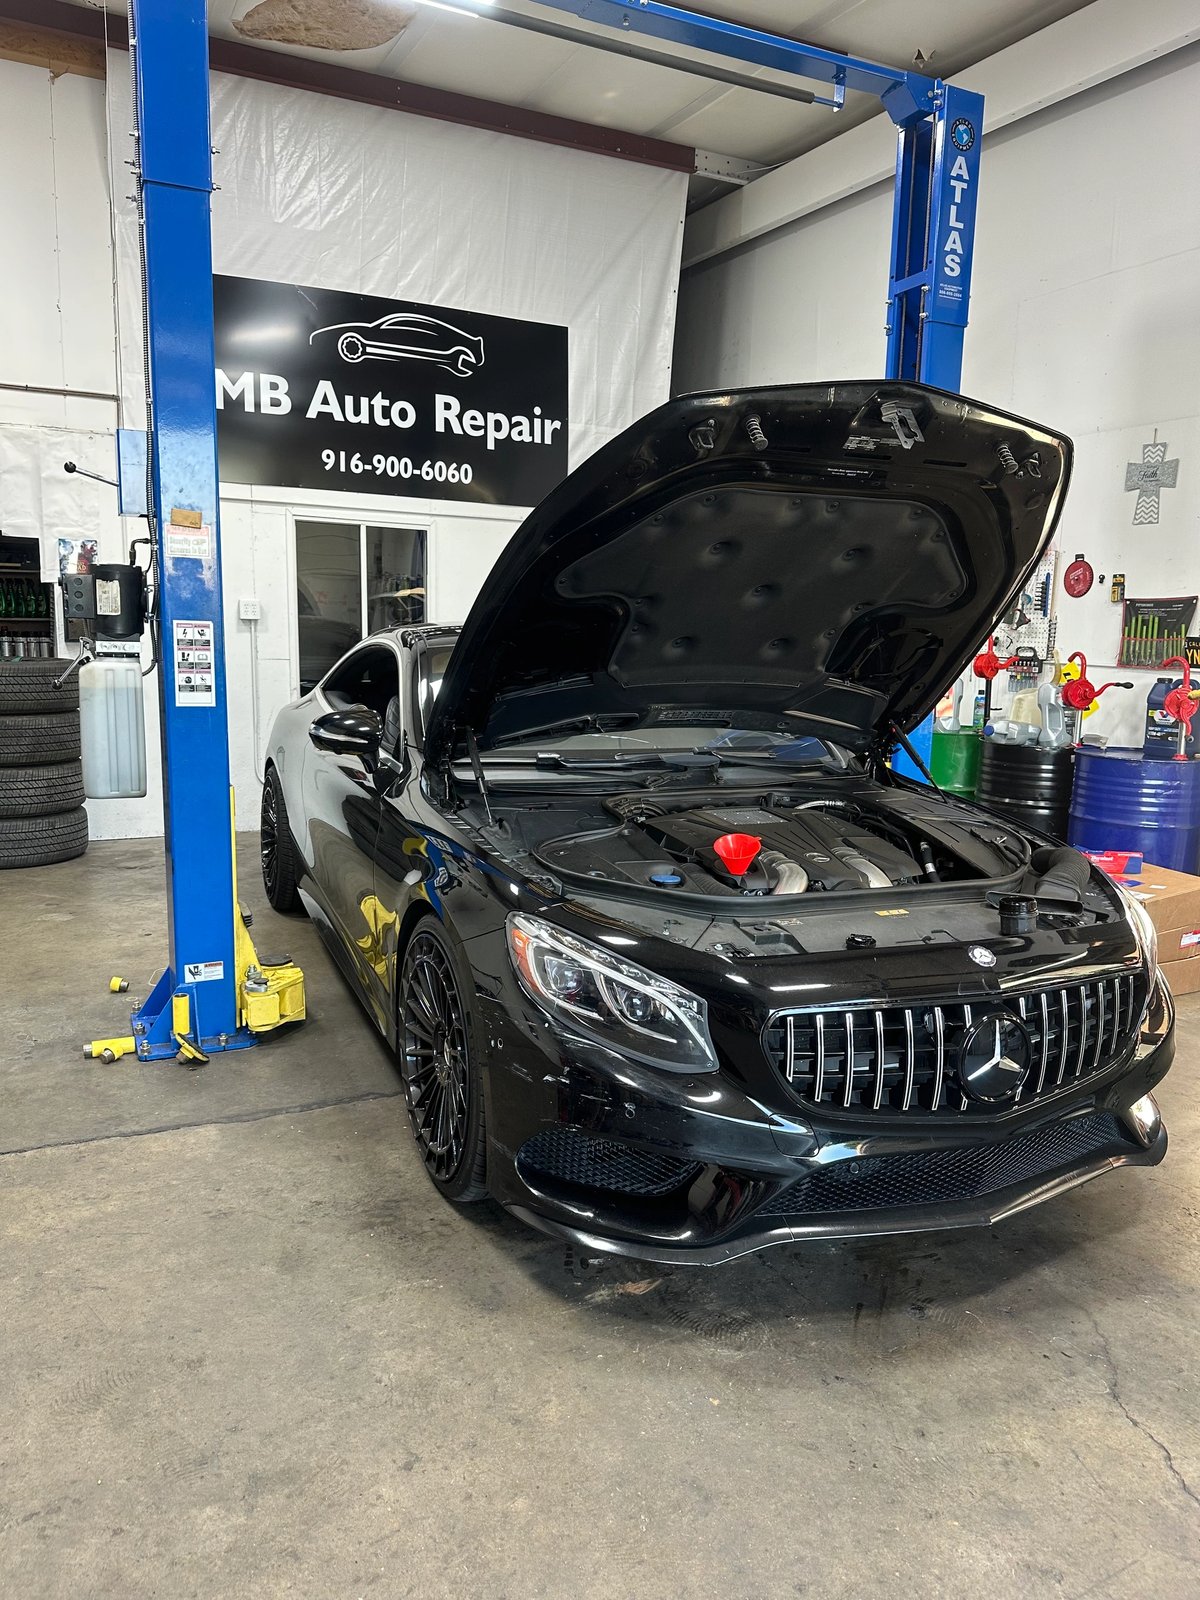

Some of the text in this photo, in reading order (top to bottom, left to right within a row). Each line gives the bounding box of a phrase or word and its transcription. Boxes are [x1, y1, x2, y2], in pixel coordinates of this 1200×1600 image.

[943, 155, 970, 278] ATLAS
[215, 367, 562, 450] MB Auto Repair
[321, 448, 473, 485] 916-900-6060
